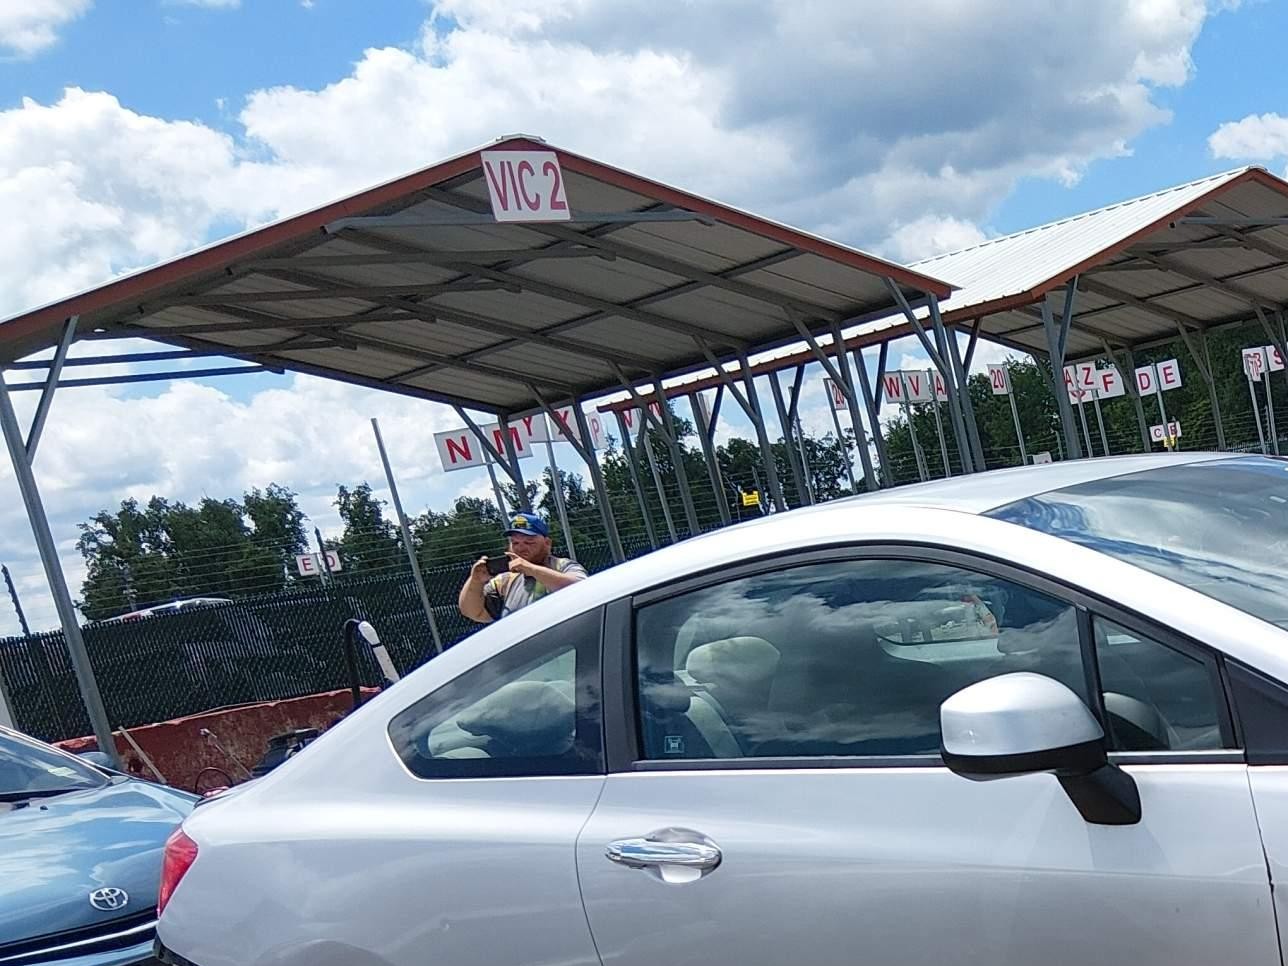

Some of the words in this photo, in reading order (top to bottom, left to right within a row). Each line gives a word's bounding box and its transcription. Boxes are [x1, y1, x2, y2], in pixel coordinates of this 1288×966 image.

[990, 369, 1005, 389] 20
[1081, 366, 1094, 386] Z
[1102, 373, 1114, 393] F
[1138, 372, 1151, 390] D
[1163, 365, 1176, 385] E
[884, 377, 900, 398] W
[908, 375, 919, 396] V
[492, 427, 523, 455] M
[1153, 428, 1162, 438] C
[445, 436, 473, 464] N
[301, 558, 314, 571] E
